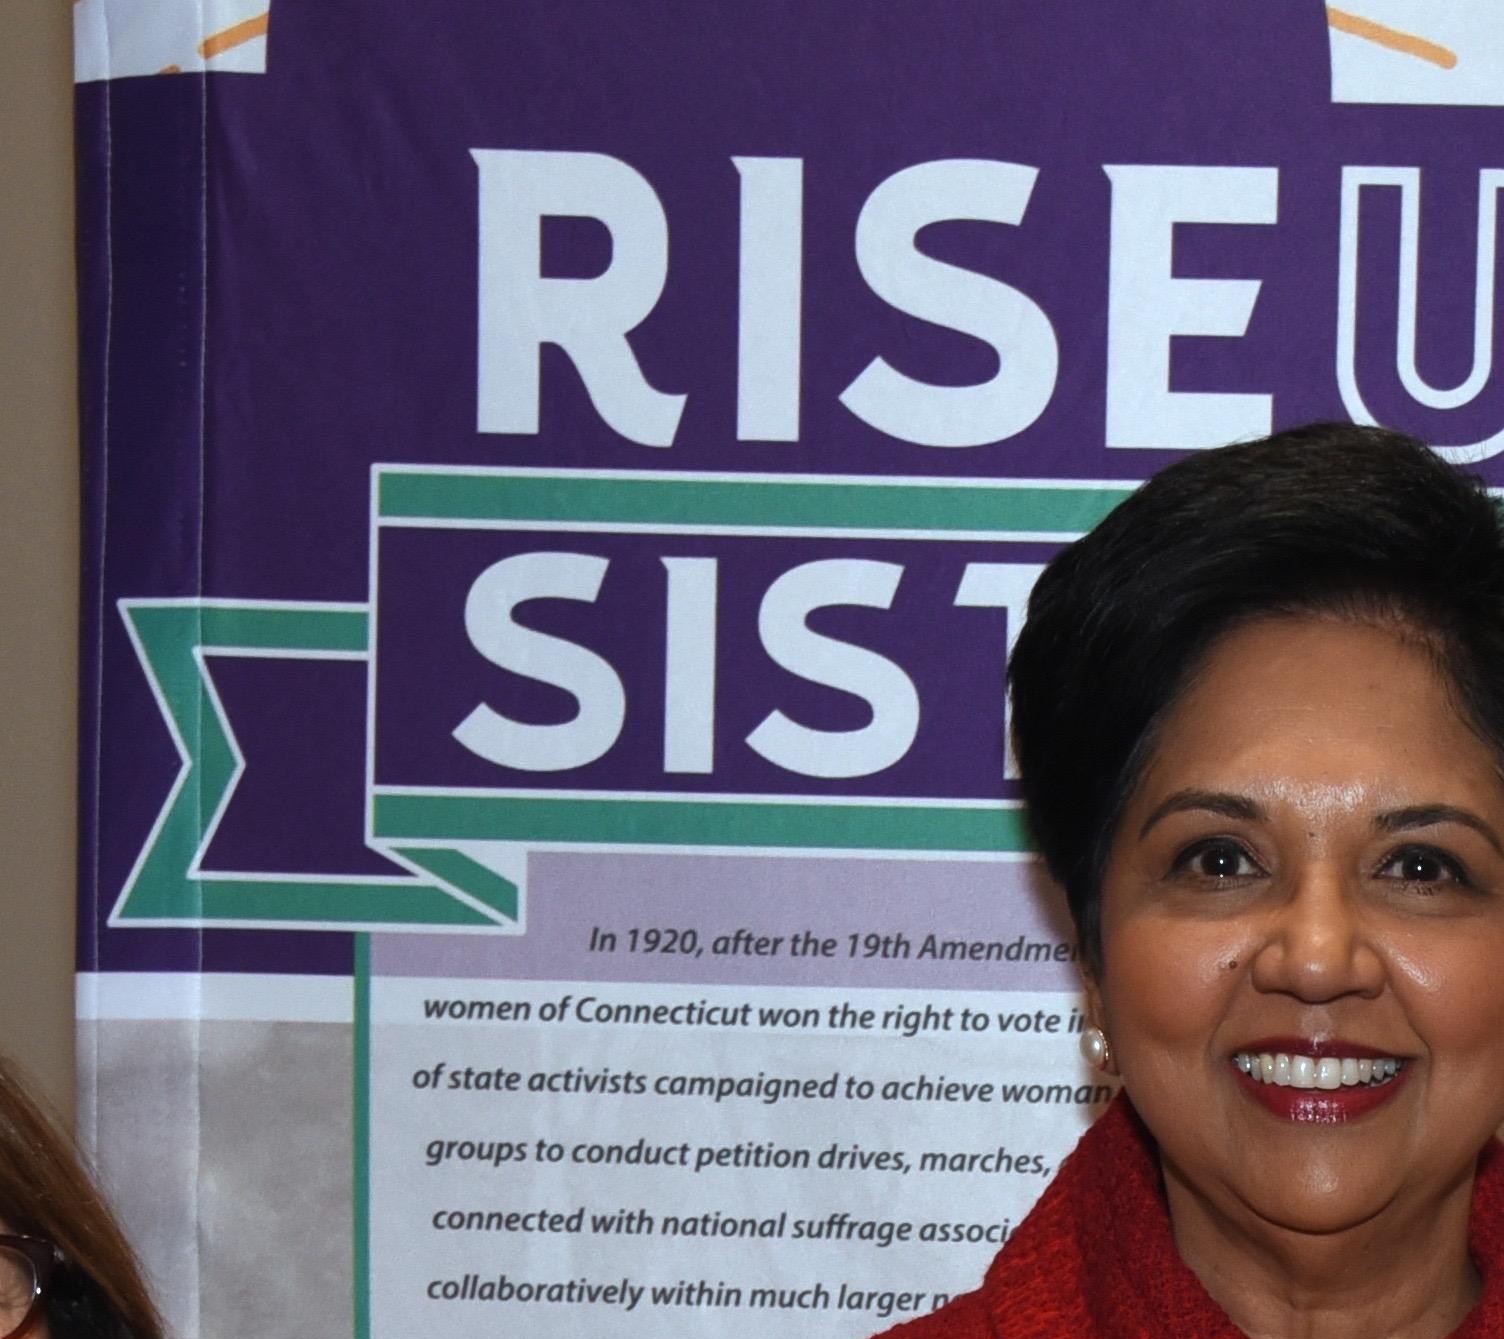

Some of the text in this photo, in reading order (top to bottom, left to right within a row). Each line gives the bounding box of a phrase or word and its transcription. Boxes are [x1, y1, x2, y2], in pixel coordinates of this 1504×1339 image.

[469, 148, 1279, 451] RISE
[589, 926, 617, 952] In
[628, 928, 704, 958] 1920,
[711, 929, 783, 957] after
[790, 930, 837, 957] the
[847, 933, 911, 959] 19th
[424, 999, 530, 1022] women
[539, 995, 573, 1022] of
[576, 996, 752, 1027] Connecticut
[758, 1005, 820, 1029] won
[829, 1003, 875, 1029] the
[882, 1004, 952, 1037] right
[960, 1009, 989, 1033] to
[998, 1010, 1060, 1034] vote
[412, 1063, 446, 1090] of
[448, 1067, 522, 1092] state
[528, 1067, 648, 1095] activists
[654, 1072, 839, 1104] campaigned
[845, 1076, 874, 1100] to
[881, 1075, 995, 1103] achieve
[1001, 1081, 1113, 1105] woman
[425, 1138, 527, 1166] groups
[536, 1139, 565, 1163] to
[572, 1138, 691, 1166] conduct
[695, 1141, 810, 1173] petition
[817, 1144, 911, 1174] drives,
[920, 1146, 1052, 1177] marches,
[432, 1207, 585, 1235] connected
[592, 1209, 654, 1236] with
[661, 1211, 788, 1240] national
[792, 1213, 912, 1247] suffrage
[426, 1274, 645, 1311] collaboratively
[651, 1280, 742, 1308] within
[749, 1283, 834, 1310] much
[837, 1284, 934, 1318] larger
